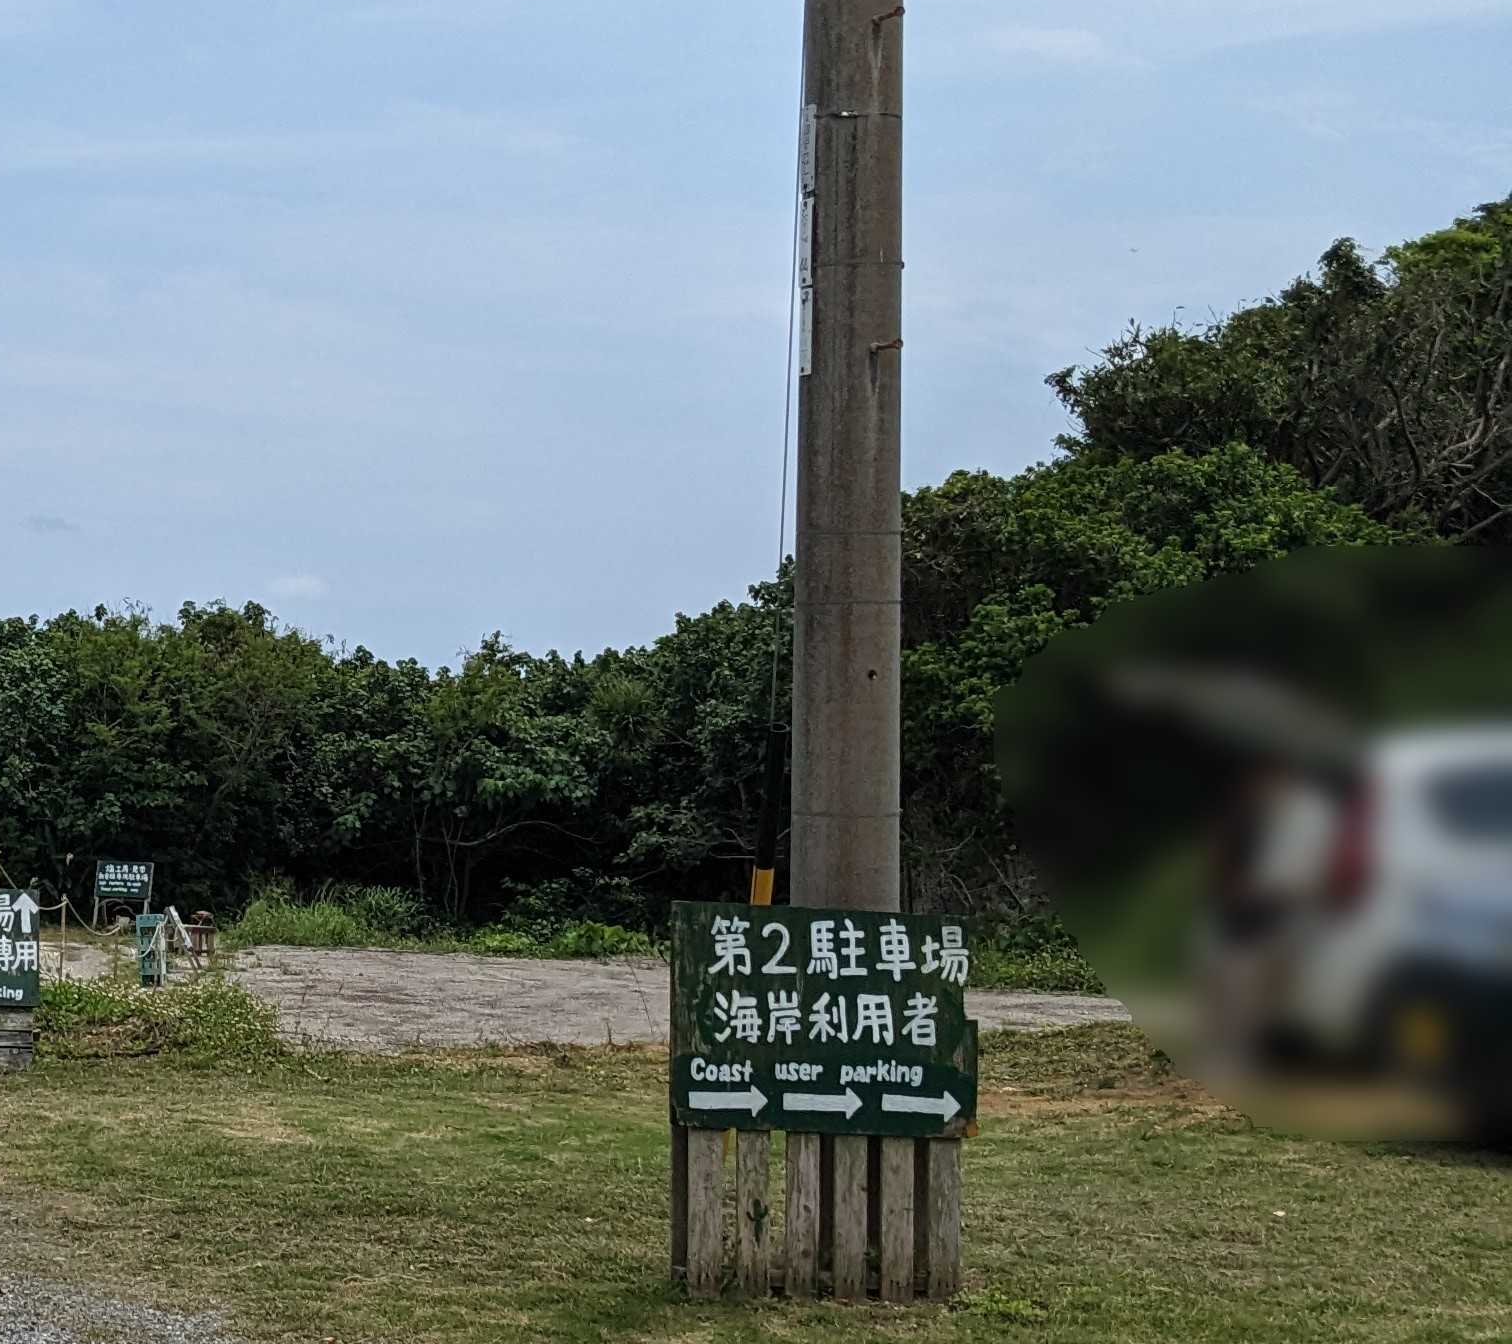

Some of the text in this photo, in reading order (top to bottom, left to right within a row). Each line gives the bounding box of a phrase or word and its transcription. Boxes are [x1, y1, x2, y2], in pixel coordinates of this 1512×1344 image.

[707, 915, 970, 987] 第2駐車場
[714, 989, 939, 1047] 海岸利用者
[690, 1057, 924, 1086] Coast user parking
